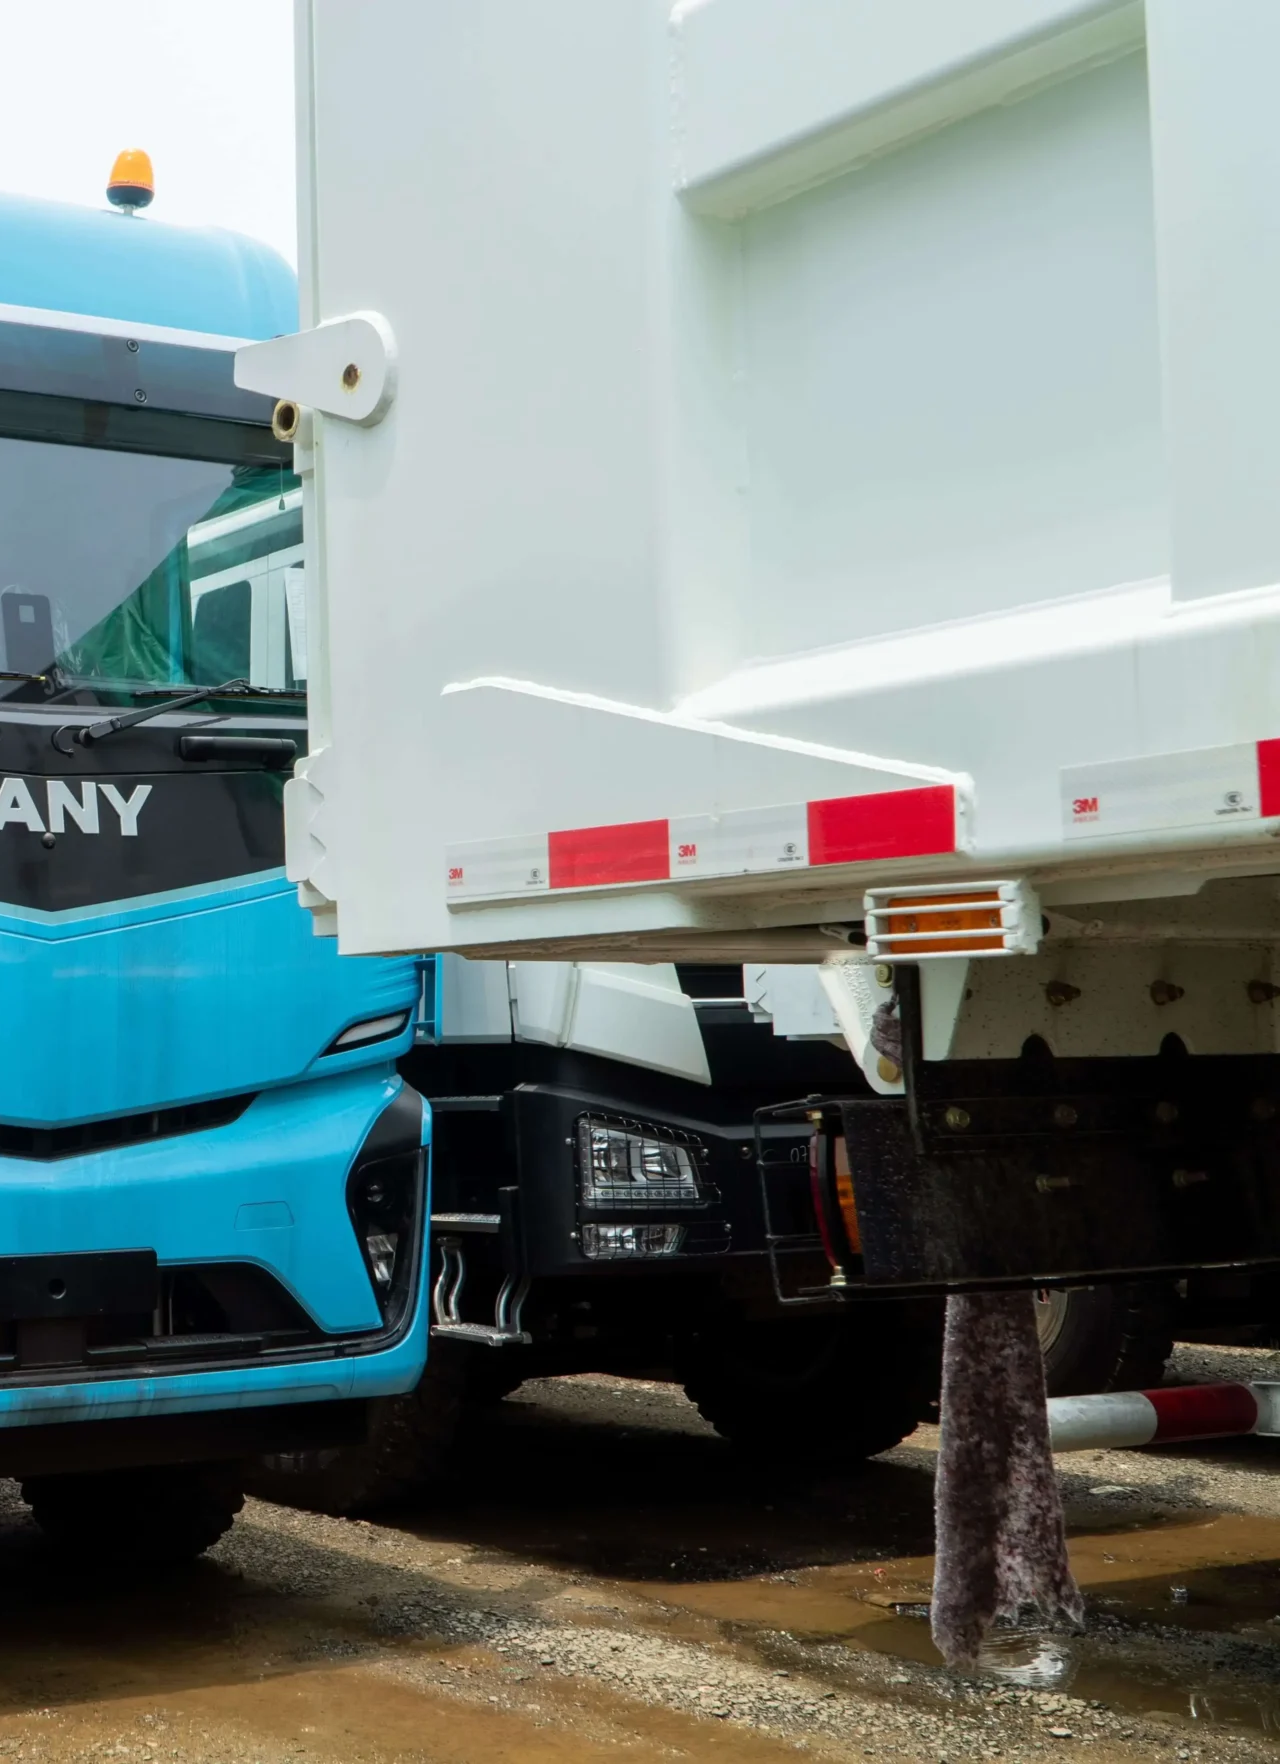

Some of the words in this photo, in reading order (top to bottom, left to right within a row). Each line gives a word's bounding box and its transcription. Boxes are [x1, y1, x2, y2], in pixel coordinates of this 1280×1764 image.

[1072, 798, 1098, 814] 3M
[678, 844, 696, 857] 3M
[448, 867, 463, 879] 3M
[790, 1145, 810, 1162] 07
